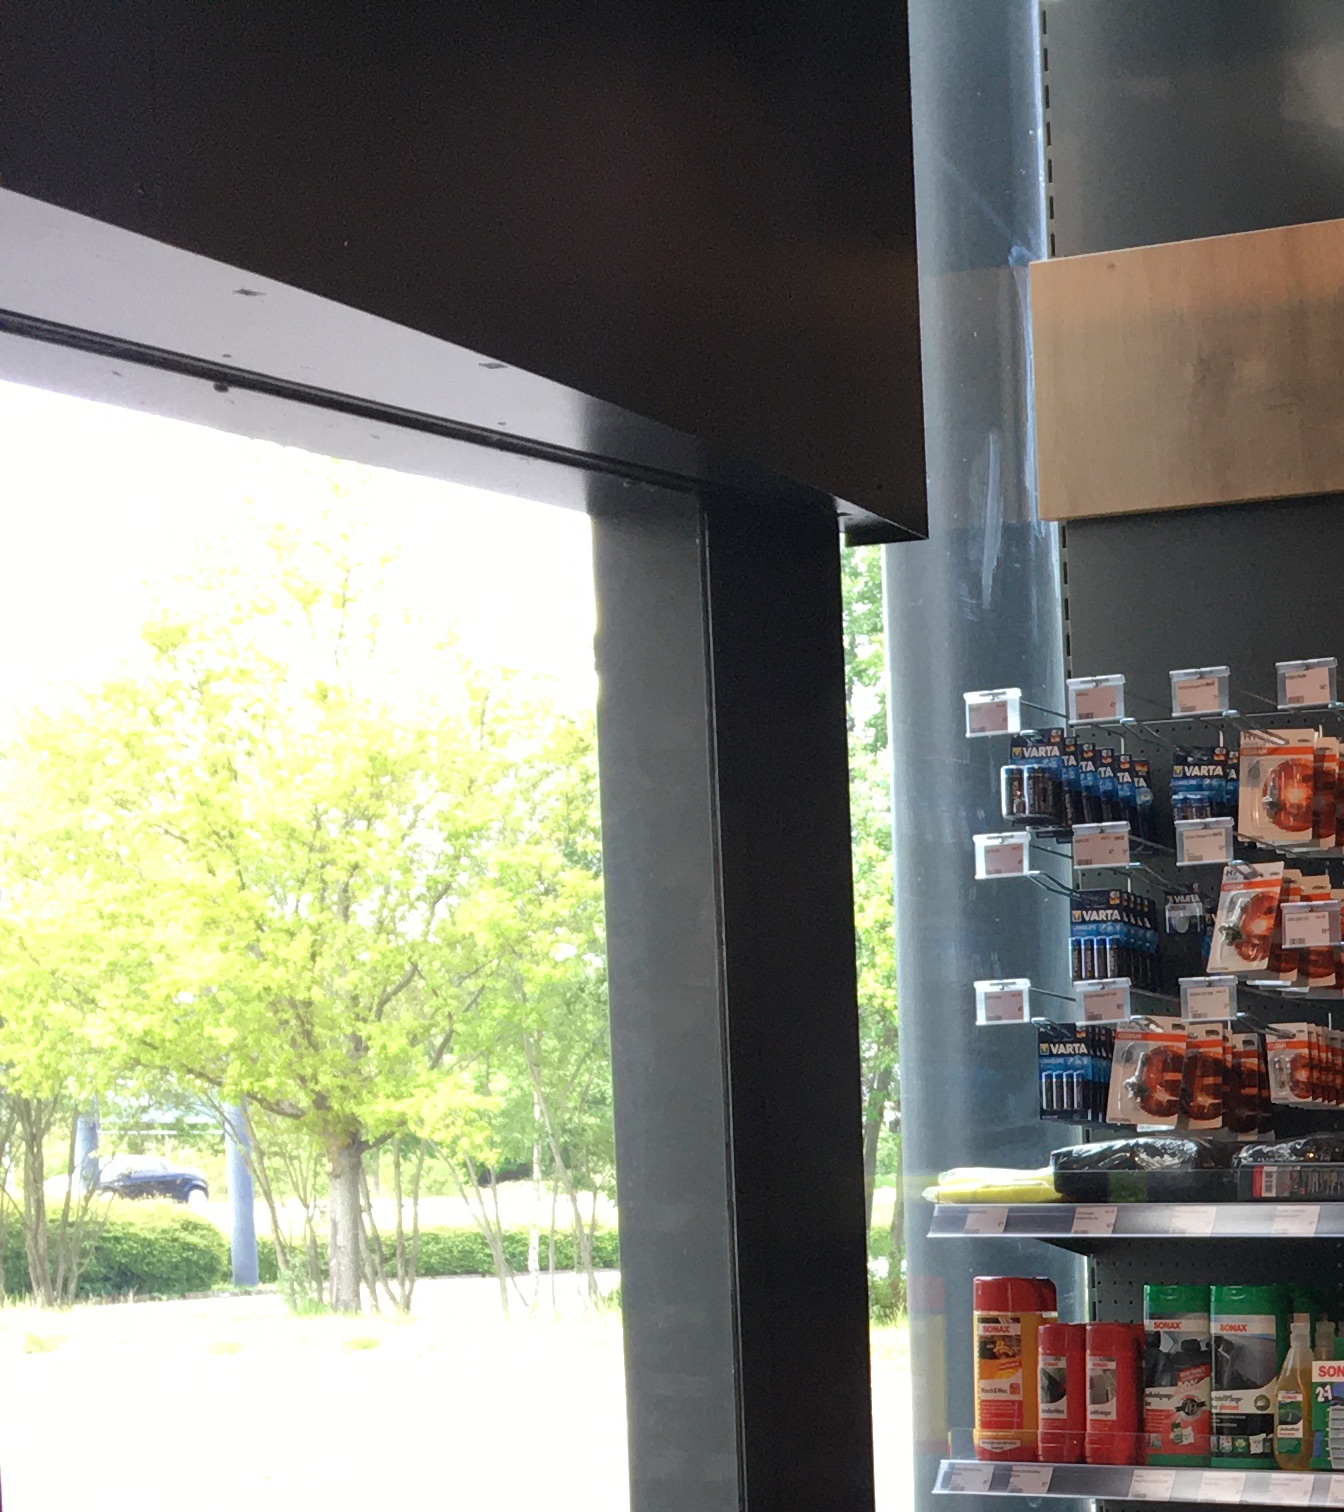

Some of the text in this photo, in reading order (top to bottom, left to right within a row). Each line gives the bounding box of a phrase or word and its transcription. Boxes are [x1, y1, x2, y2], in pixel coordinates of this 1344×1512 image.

[1023, 746, 1060, 758] VARTA
[1184, 765, 1223, 776] VARTA
[1083, 910, 1120, 922] VARTA
[1051, 1043, 1088, 1054] VARTA
[983, 1325, 1010, 1333] SONAX
[1154, 1321, 1182, 1329] SONAX
[1220, 1324, 1248, 1332] SONAX
